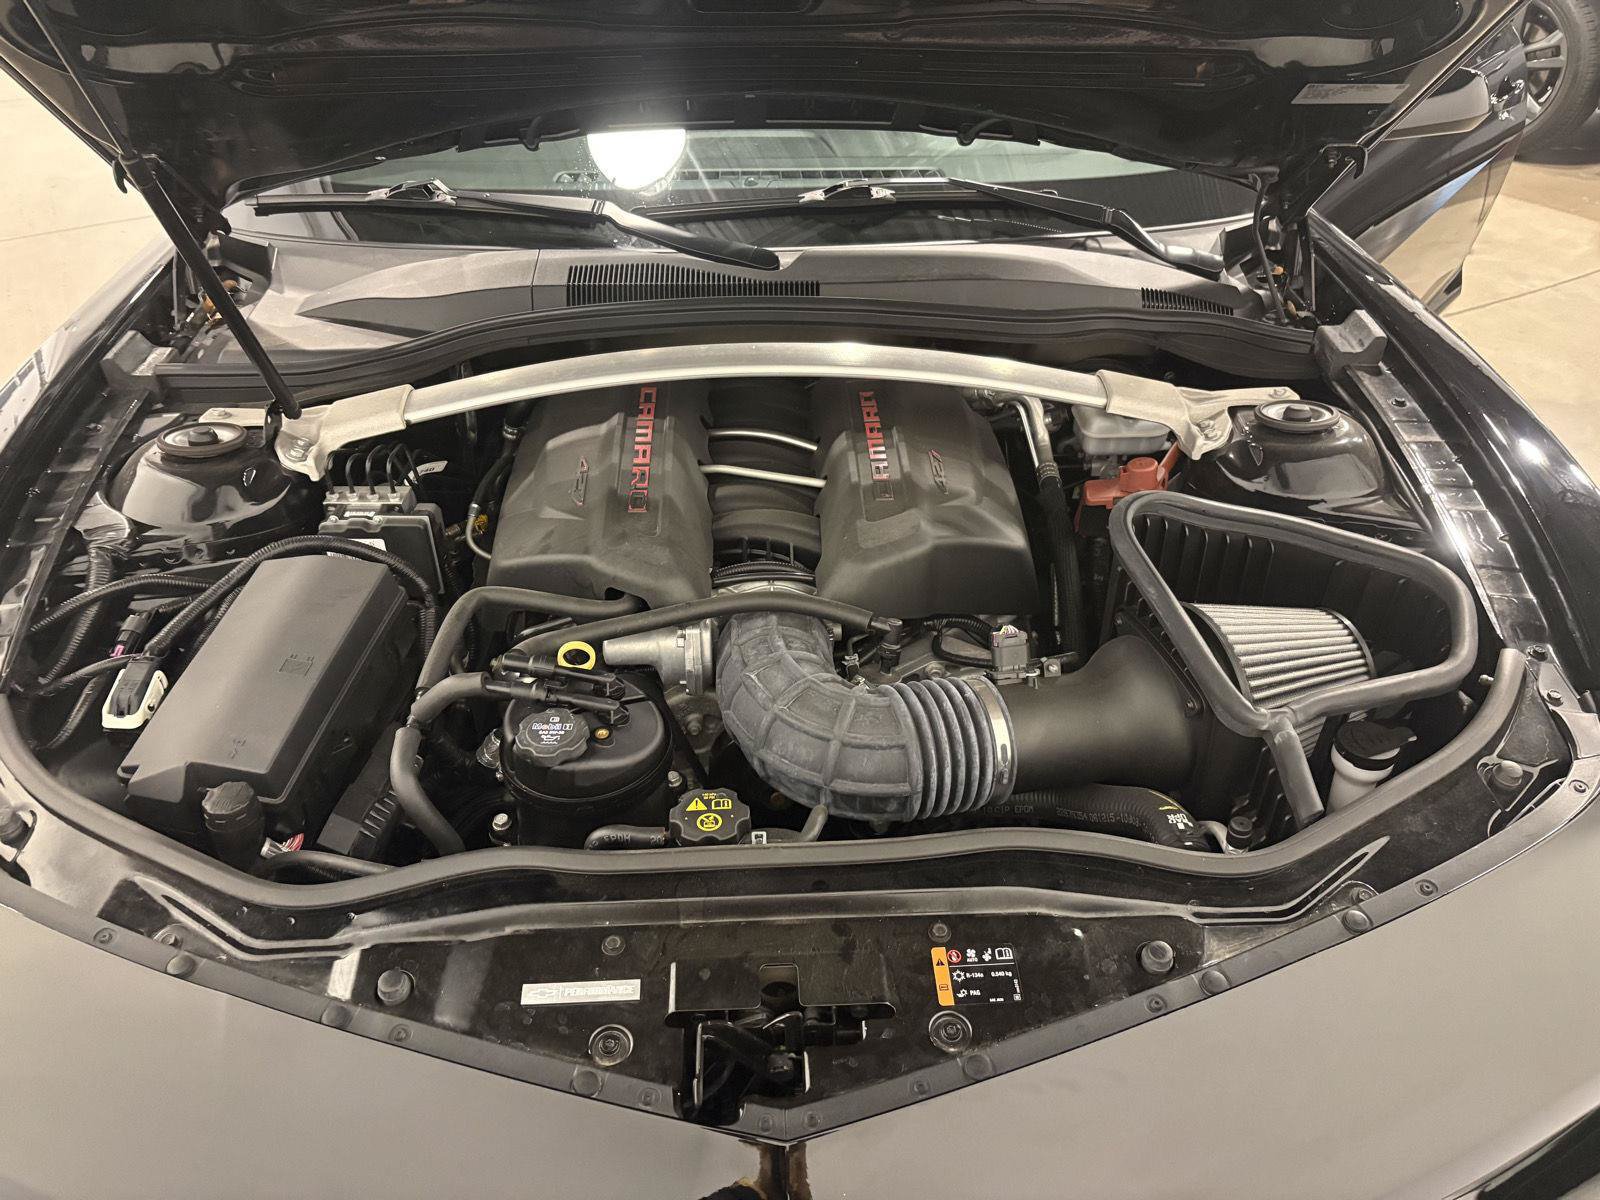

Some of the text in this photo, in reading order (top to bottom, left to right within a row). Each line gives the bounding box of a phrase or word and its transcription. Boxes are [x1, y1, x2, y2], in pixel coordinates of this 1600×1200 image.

[628, 386, 657, 512] CAMARO
[859, 390, 895, 500] CAMARO
[531, 722, 562, 731] Mobil
[563, 985, 636, 997] PERFORMANCE
